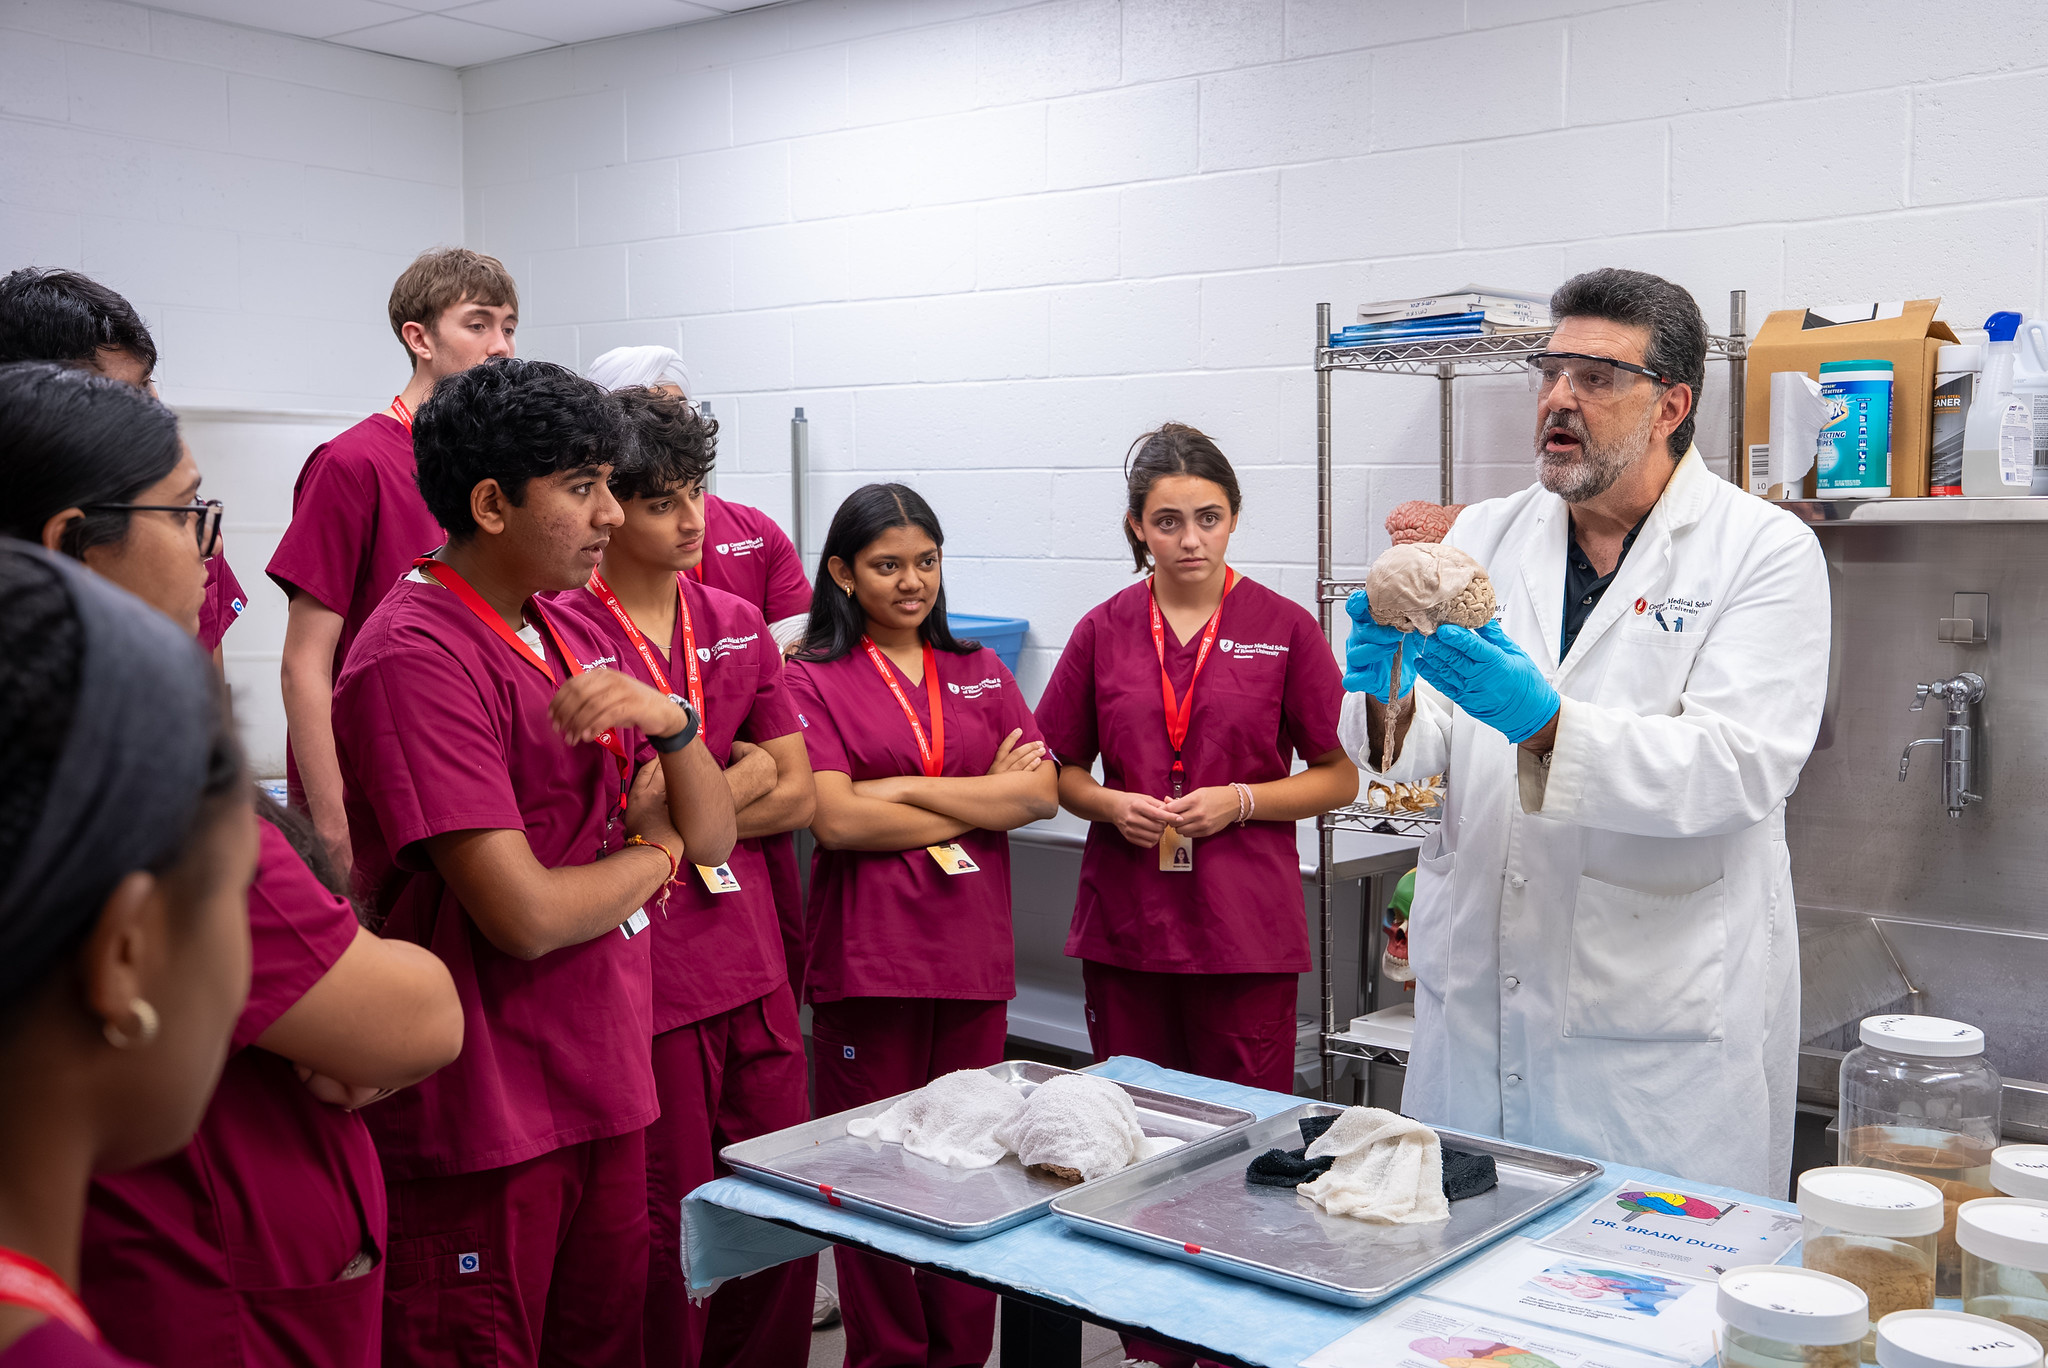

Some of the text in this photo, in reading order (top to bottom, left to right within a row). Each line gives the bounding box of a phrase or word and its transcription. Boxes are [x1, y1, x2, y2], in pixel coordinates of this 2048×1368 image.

[1667, 598, 1693, 607] Medical
[1695, 600, 1712, 608] School
[1670, 604, 1699, 616] University
[1256, 649, 1279, 657] University
[1592, 1218, 1740, 1254] DR. BRAIN DUDE
